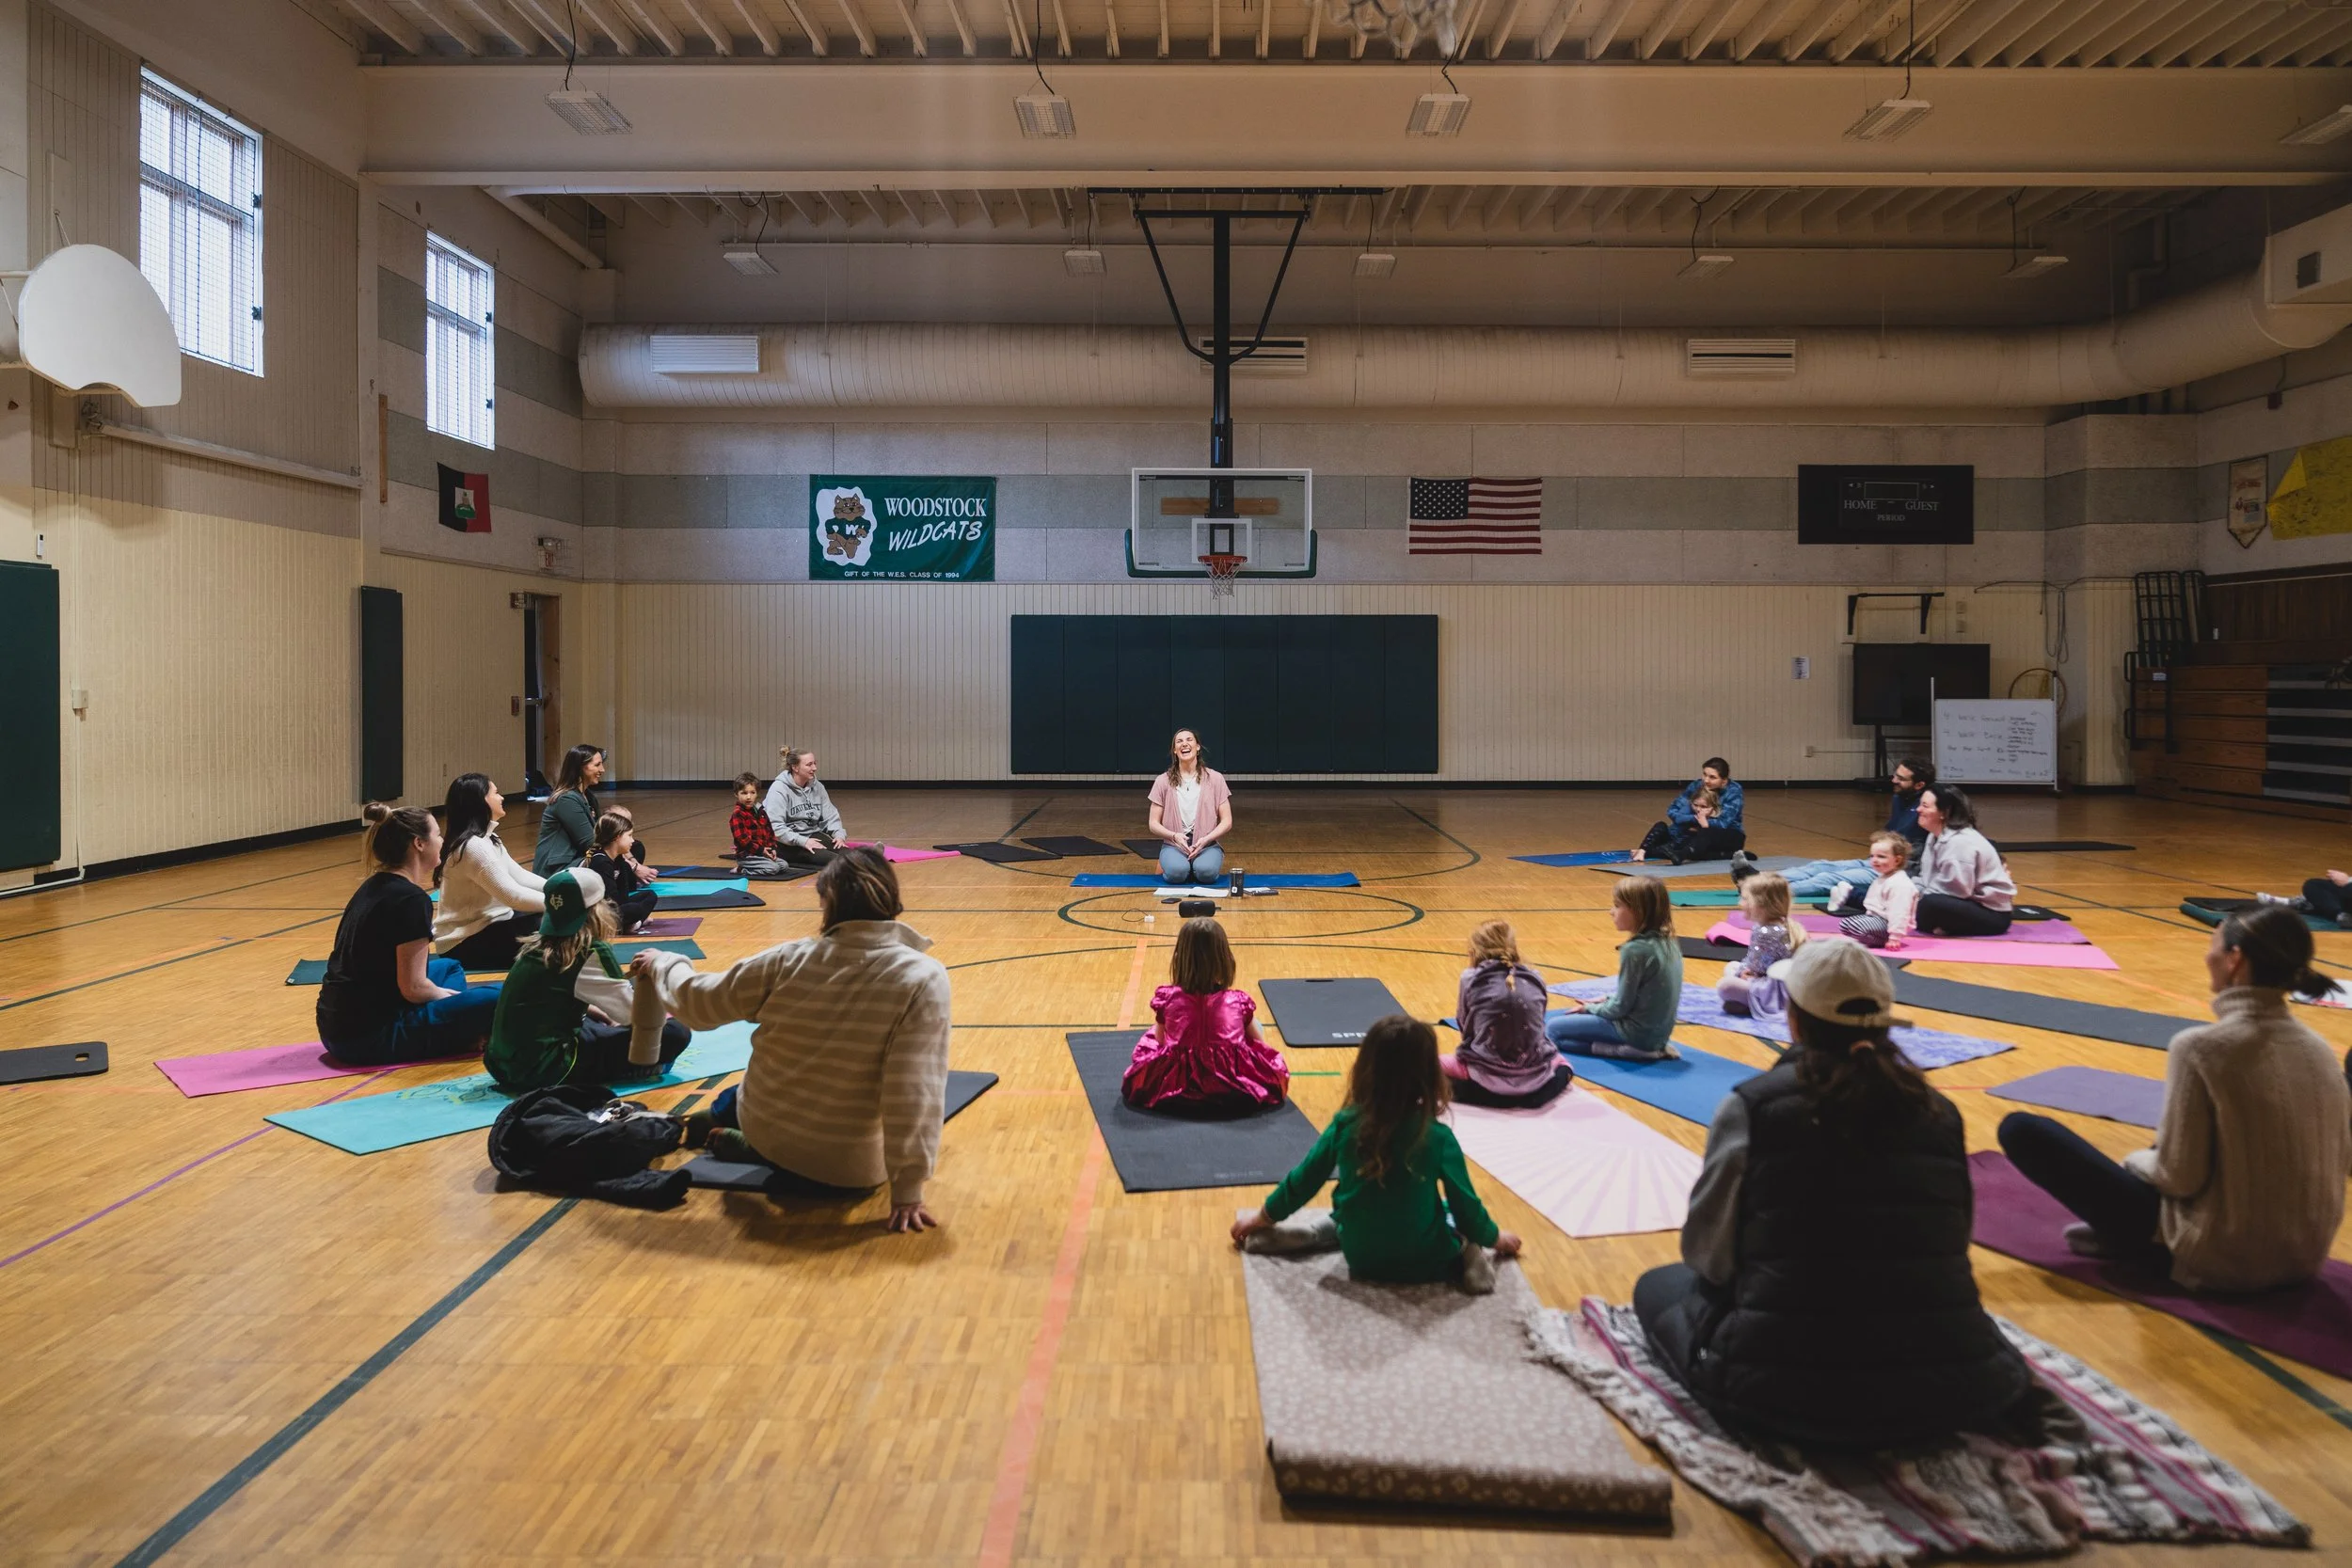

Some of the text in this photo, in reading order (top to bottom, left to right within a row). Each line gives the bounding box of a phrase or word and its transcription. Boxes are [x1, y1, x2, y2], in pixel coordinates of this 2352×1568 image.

[883, 497, 987, 517] WOODSTOCK
[1843, 499, 1940, 512] HOME GUEST
[887, 520, 983, 551] WILDCATS
